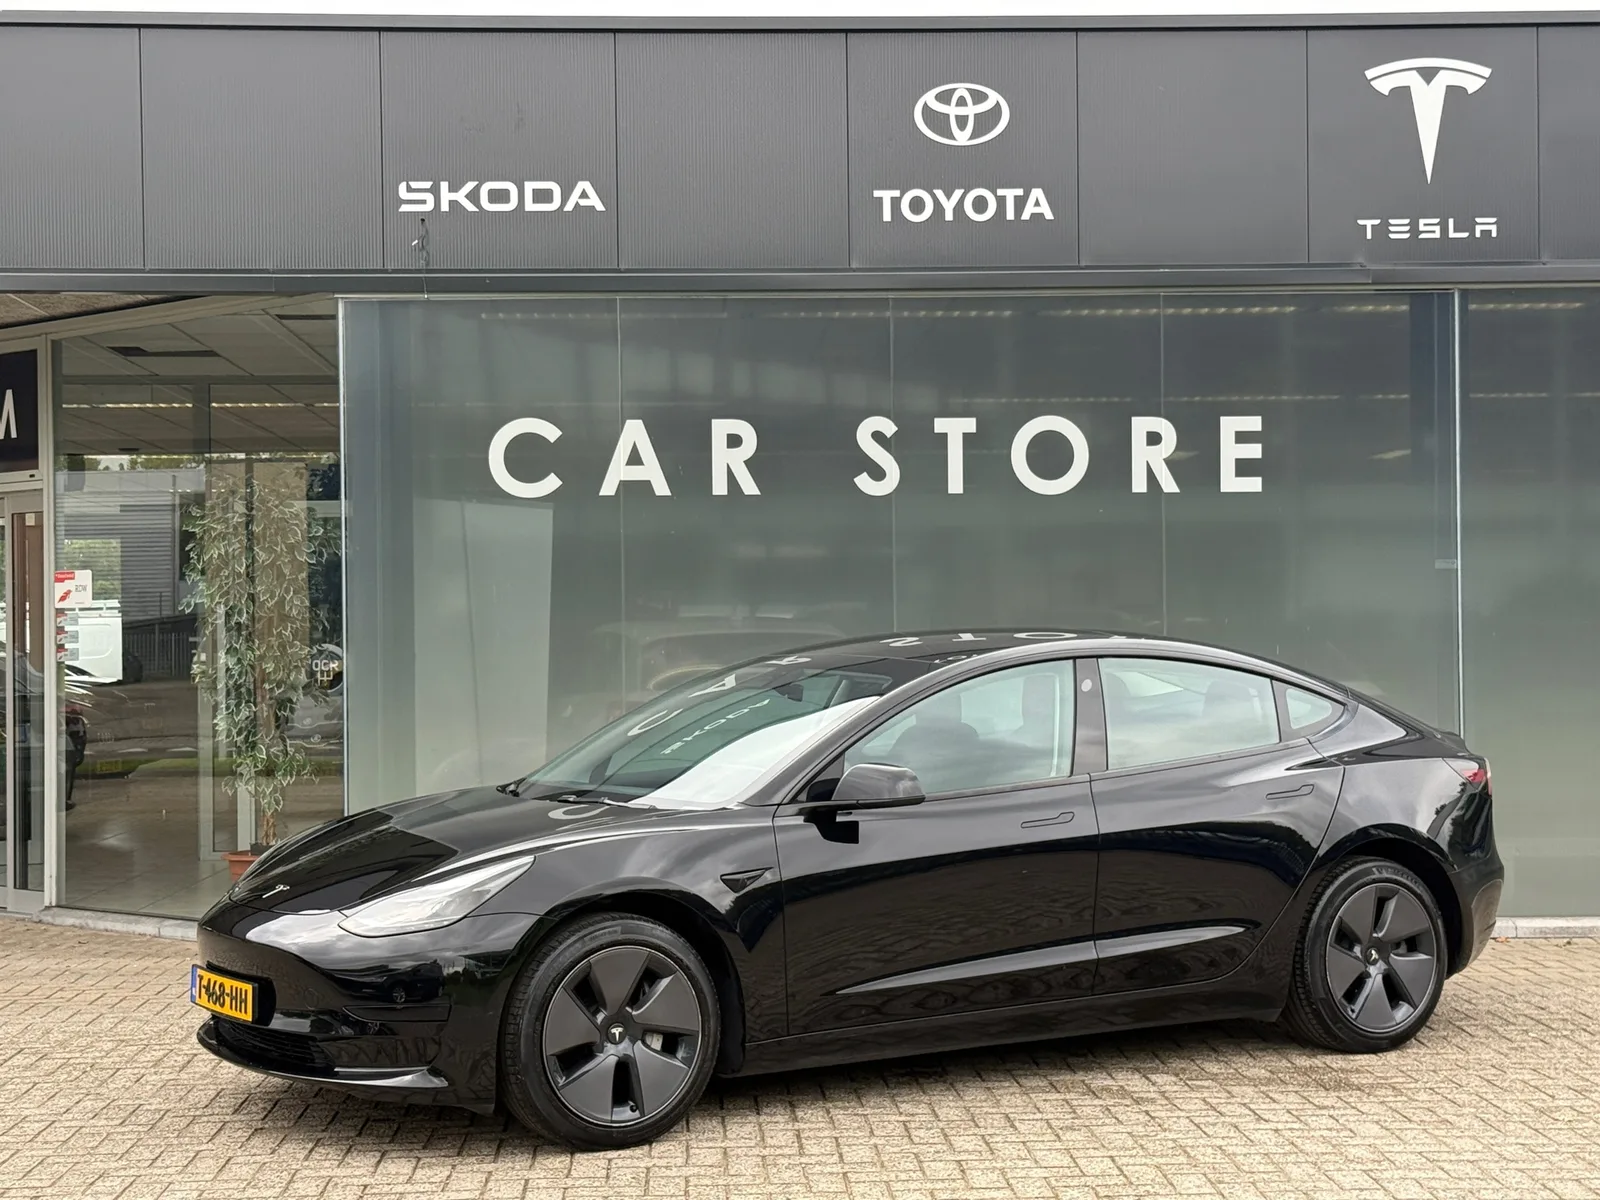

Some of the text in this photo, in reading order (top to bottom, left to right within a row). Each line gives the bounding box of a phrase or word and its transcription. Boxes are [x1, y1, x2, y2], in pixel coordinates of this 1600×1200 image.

[398, 180, 607, 212] SKODA
[873, 187, 1055, 222] TOYOTA
[1357, 217, 1498, 240] TESLA
[488, 415, 1263, 499] CAR STORE
[197, 974, 248, 1015] T-468-HH
